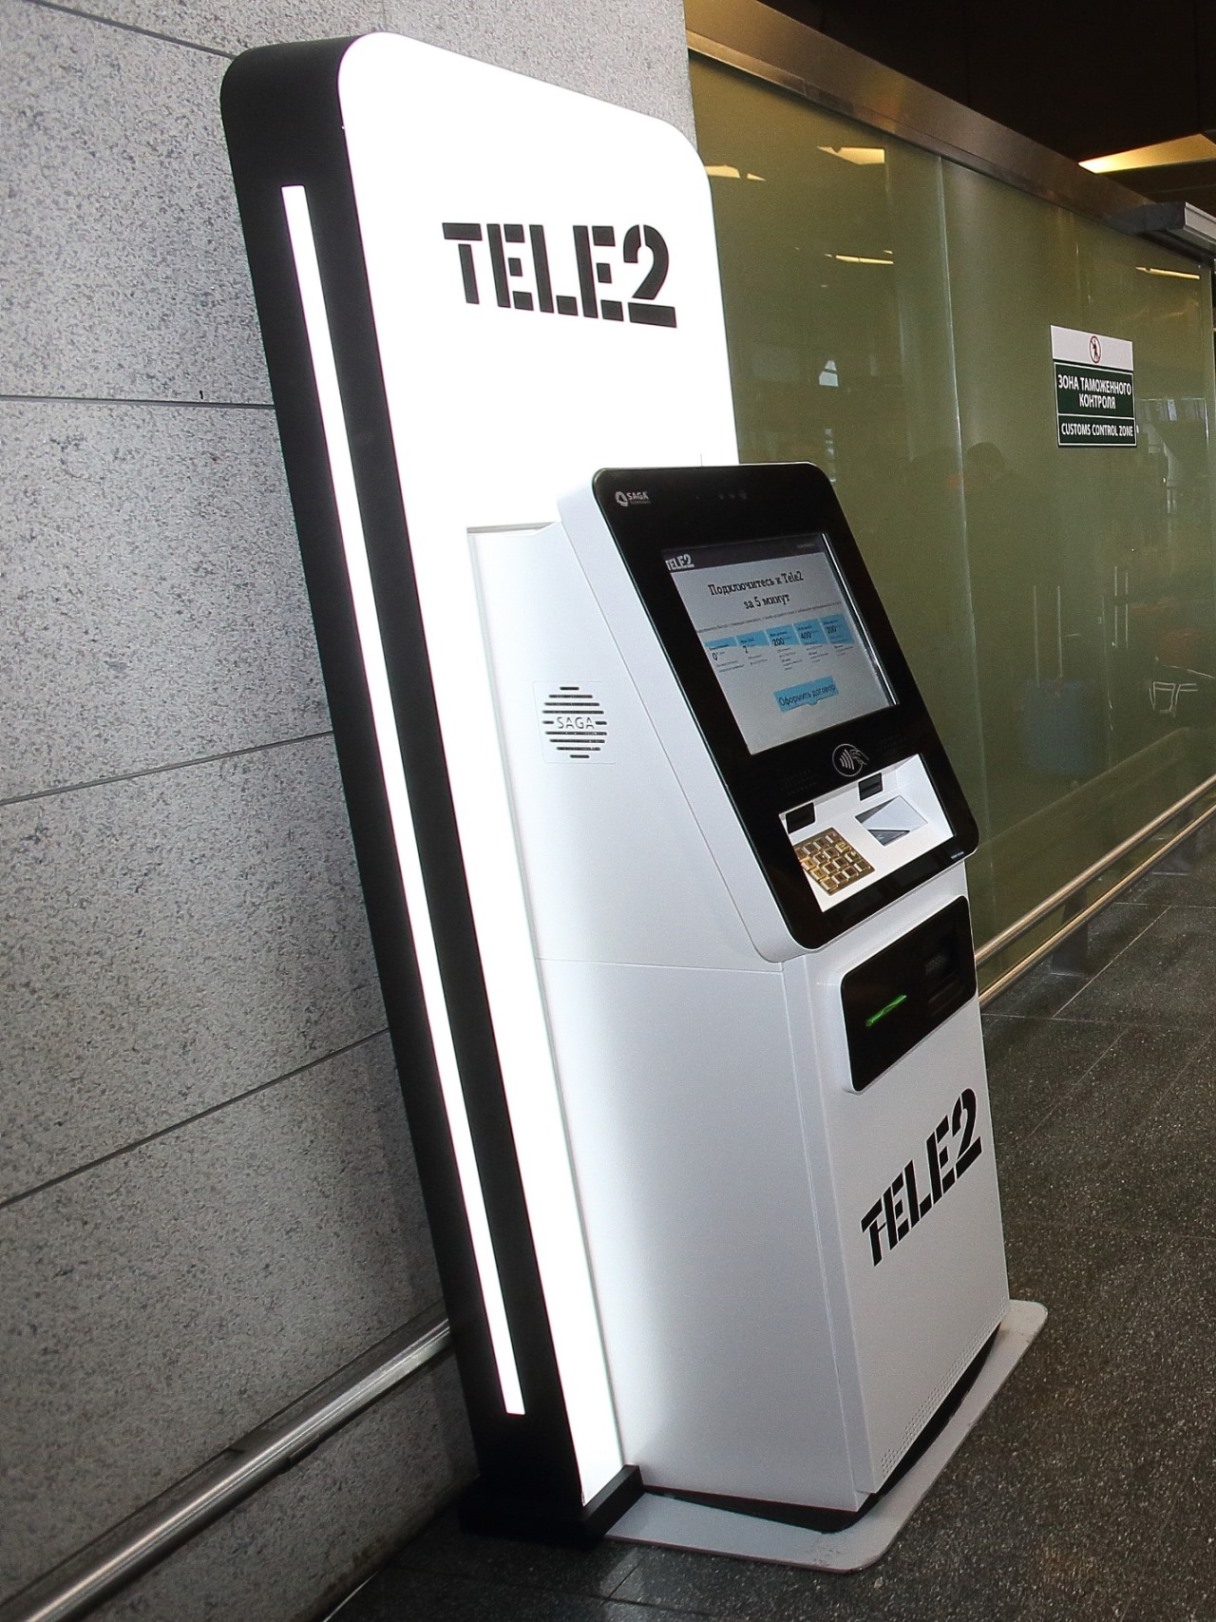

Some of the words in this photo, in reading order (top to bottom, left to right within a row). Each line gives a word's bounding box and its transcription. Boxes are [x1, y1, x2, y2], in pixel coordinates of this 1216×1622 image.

[442, 222, 677, 328] TELE2
[1058, 374, 1079, 391] ЗОНА
[1080, 377, 1132, 396] ТАМОЖЕННОГО
[1079, 393, 1116, 409] КОНТРОЛЯ
[1061, 423, 1091, 435] CUSTOMS
[1092, 424, 1118, 436] CONTROL
[1119, 425, 1134, 437] ZONE
[665, 553, 694, 571] TELE2
[708, 576, 775, 596] Подключитесь
[776, 576, 783, 584] к
[781, 571, 804, 584] Tele2
[744, 600, 754, 609] за
[754, 596, 761, 607] 5
[762, 593, 790, 606] минут
[557, 716, 594, 729] SAGA
[861, 1088, 982, 1267] TELE2
